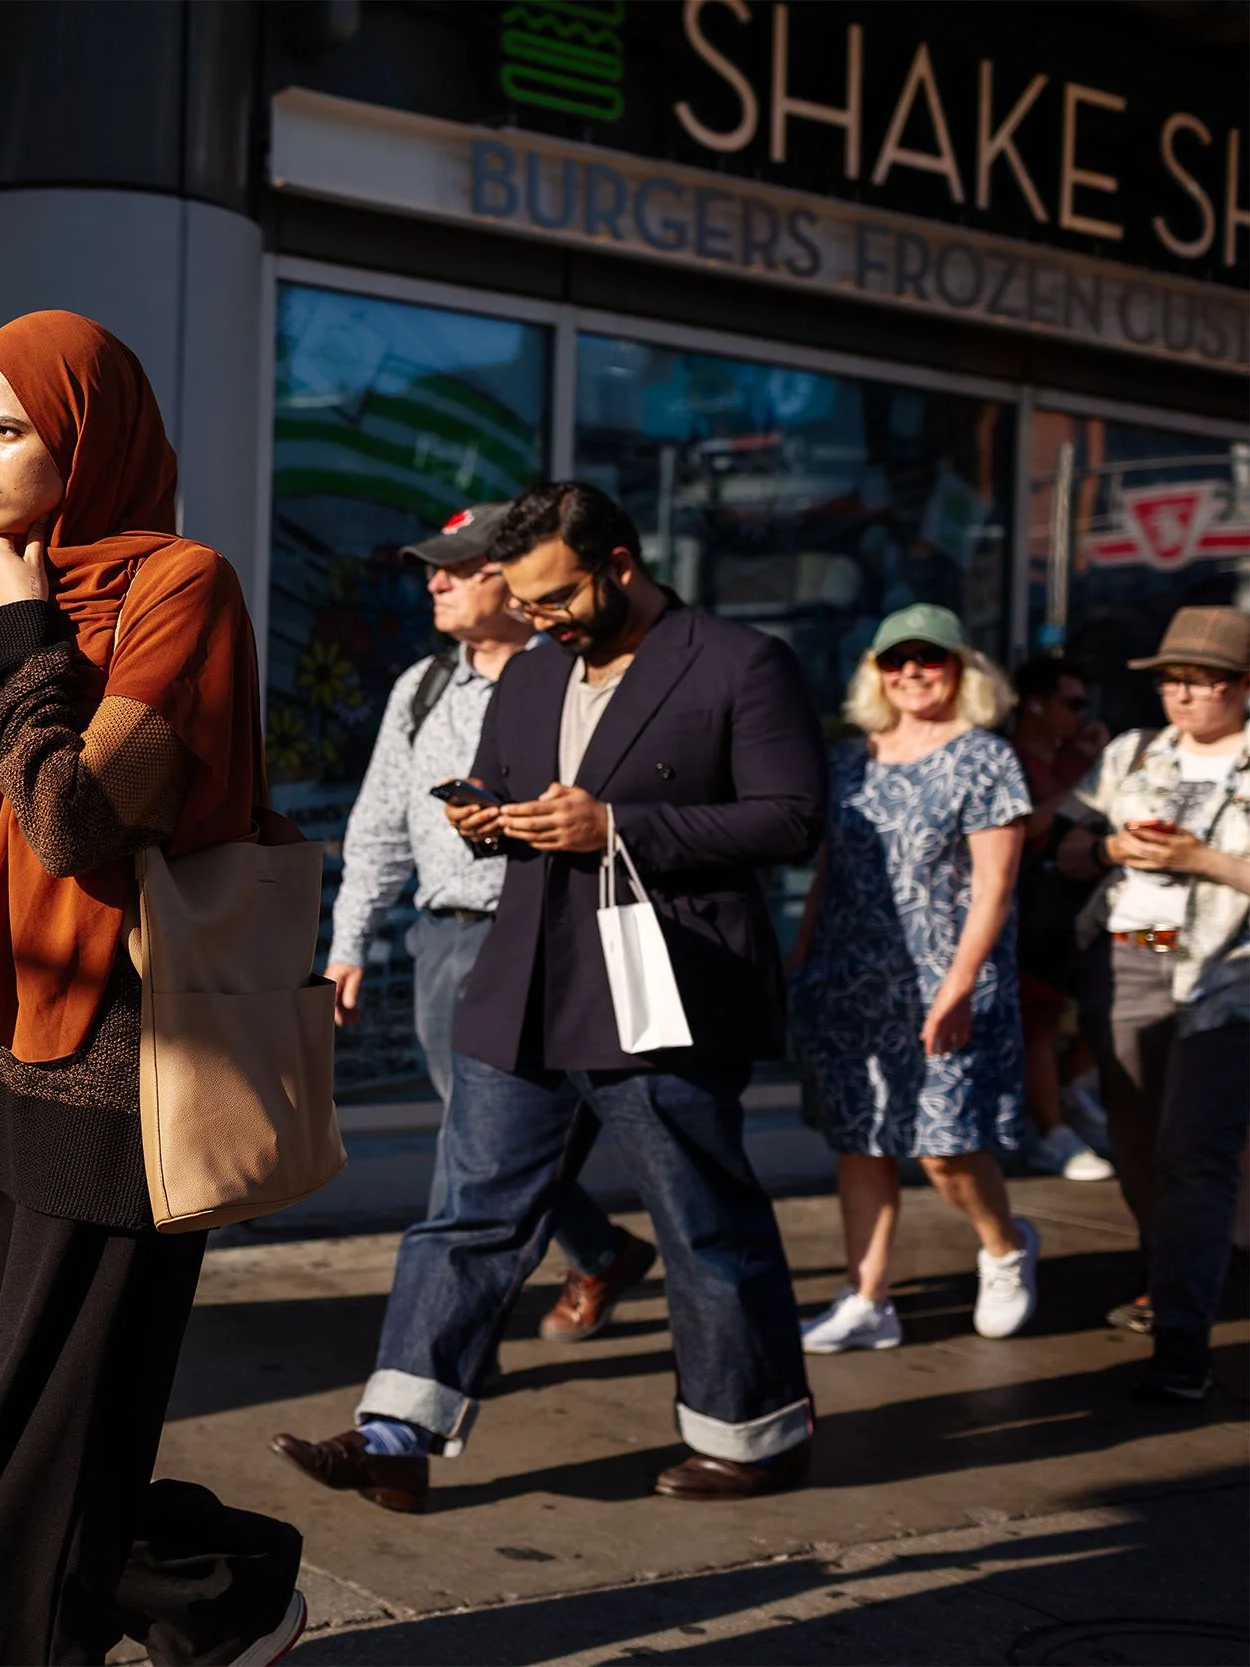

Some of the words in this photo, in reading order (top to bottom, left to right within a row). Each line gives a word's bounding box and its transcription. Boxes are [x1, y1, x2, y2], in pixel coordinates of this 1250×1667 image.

[673, 0, 1128, 241] SHAKE
[471, 139, 822, 278] BURGERS
[855, 222, 1103, 336] FROZEN
